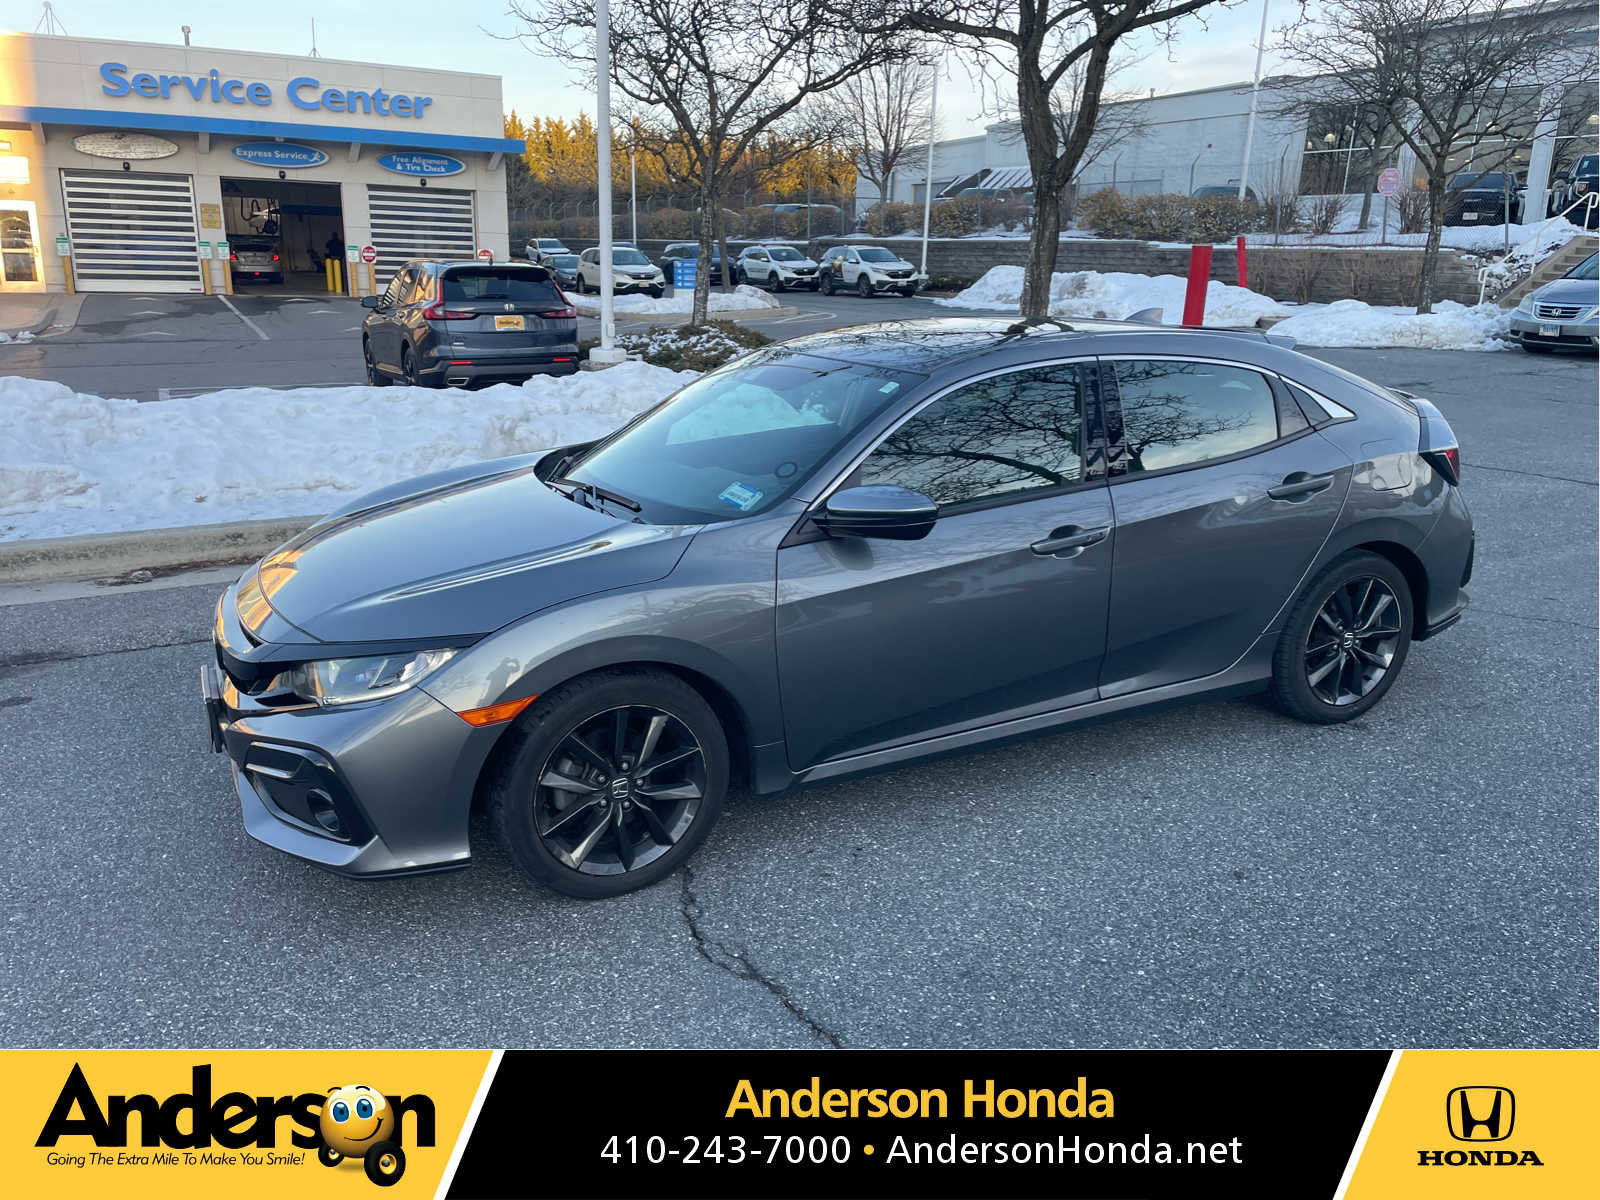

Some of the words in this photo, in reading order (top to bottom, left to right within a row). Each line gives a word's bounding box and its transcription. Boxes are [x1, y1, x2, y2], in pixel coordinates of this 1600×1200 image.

[100, 62, 273, 106] Service
[287, 76, 433, 119] Center
[235, 147, 272, 159] Express
[274, 150, 307, 161] Service
